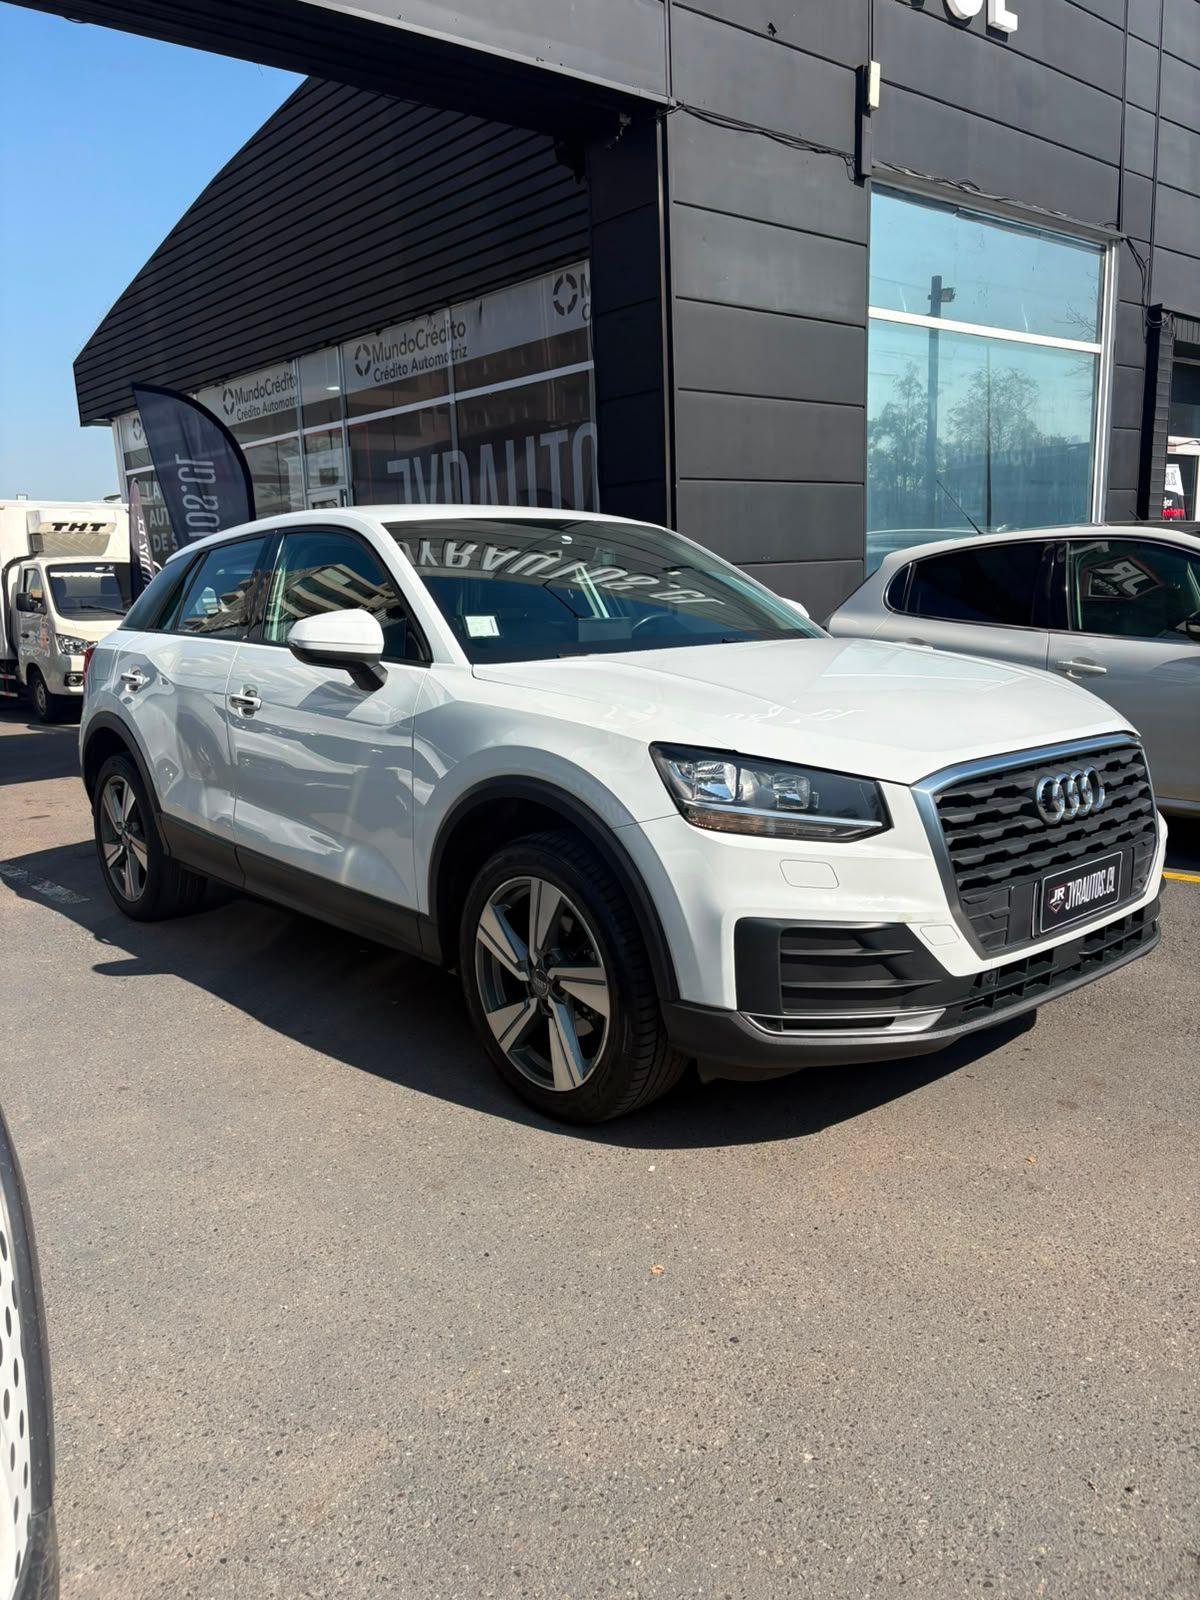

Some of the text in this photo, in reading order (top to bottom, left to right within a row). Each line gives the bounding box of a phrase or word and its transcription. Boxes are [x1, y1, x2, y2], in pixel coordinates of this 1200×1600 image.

[373, 361, 408, 383] Crédito
[236, 404, 261, 421] Crédito
[52, 522, 107, 532] THT
